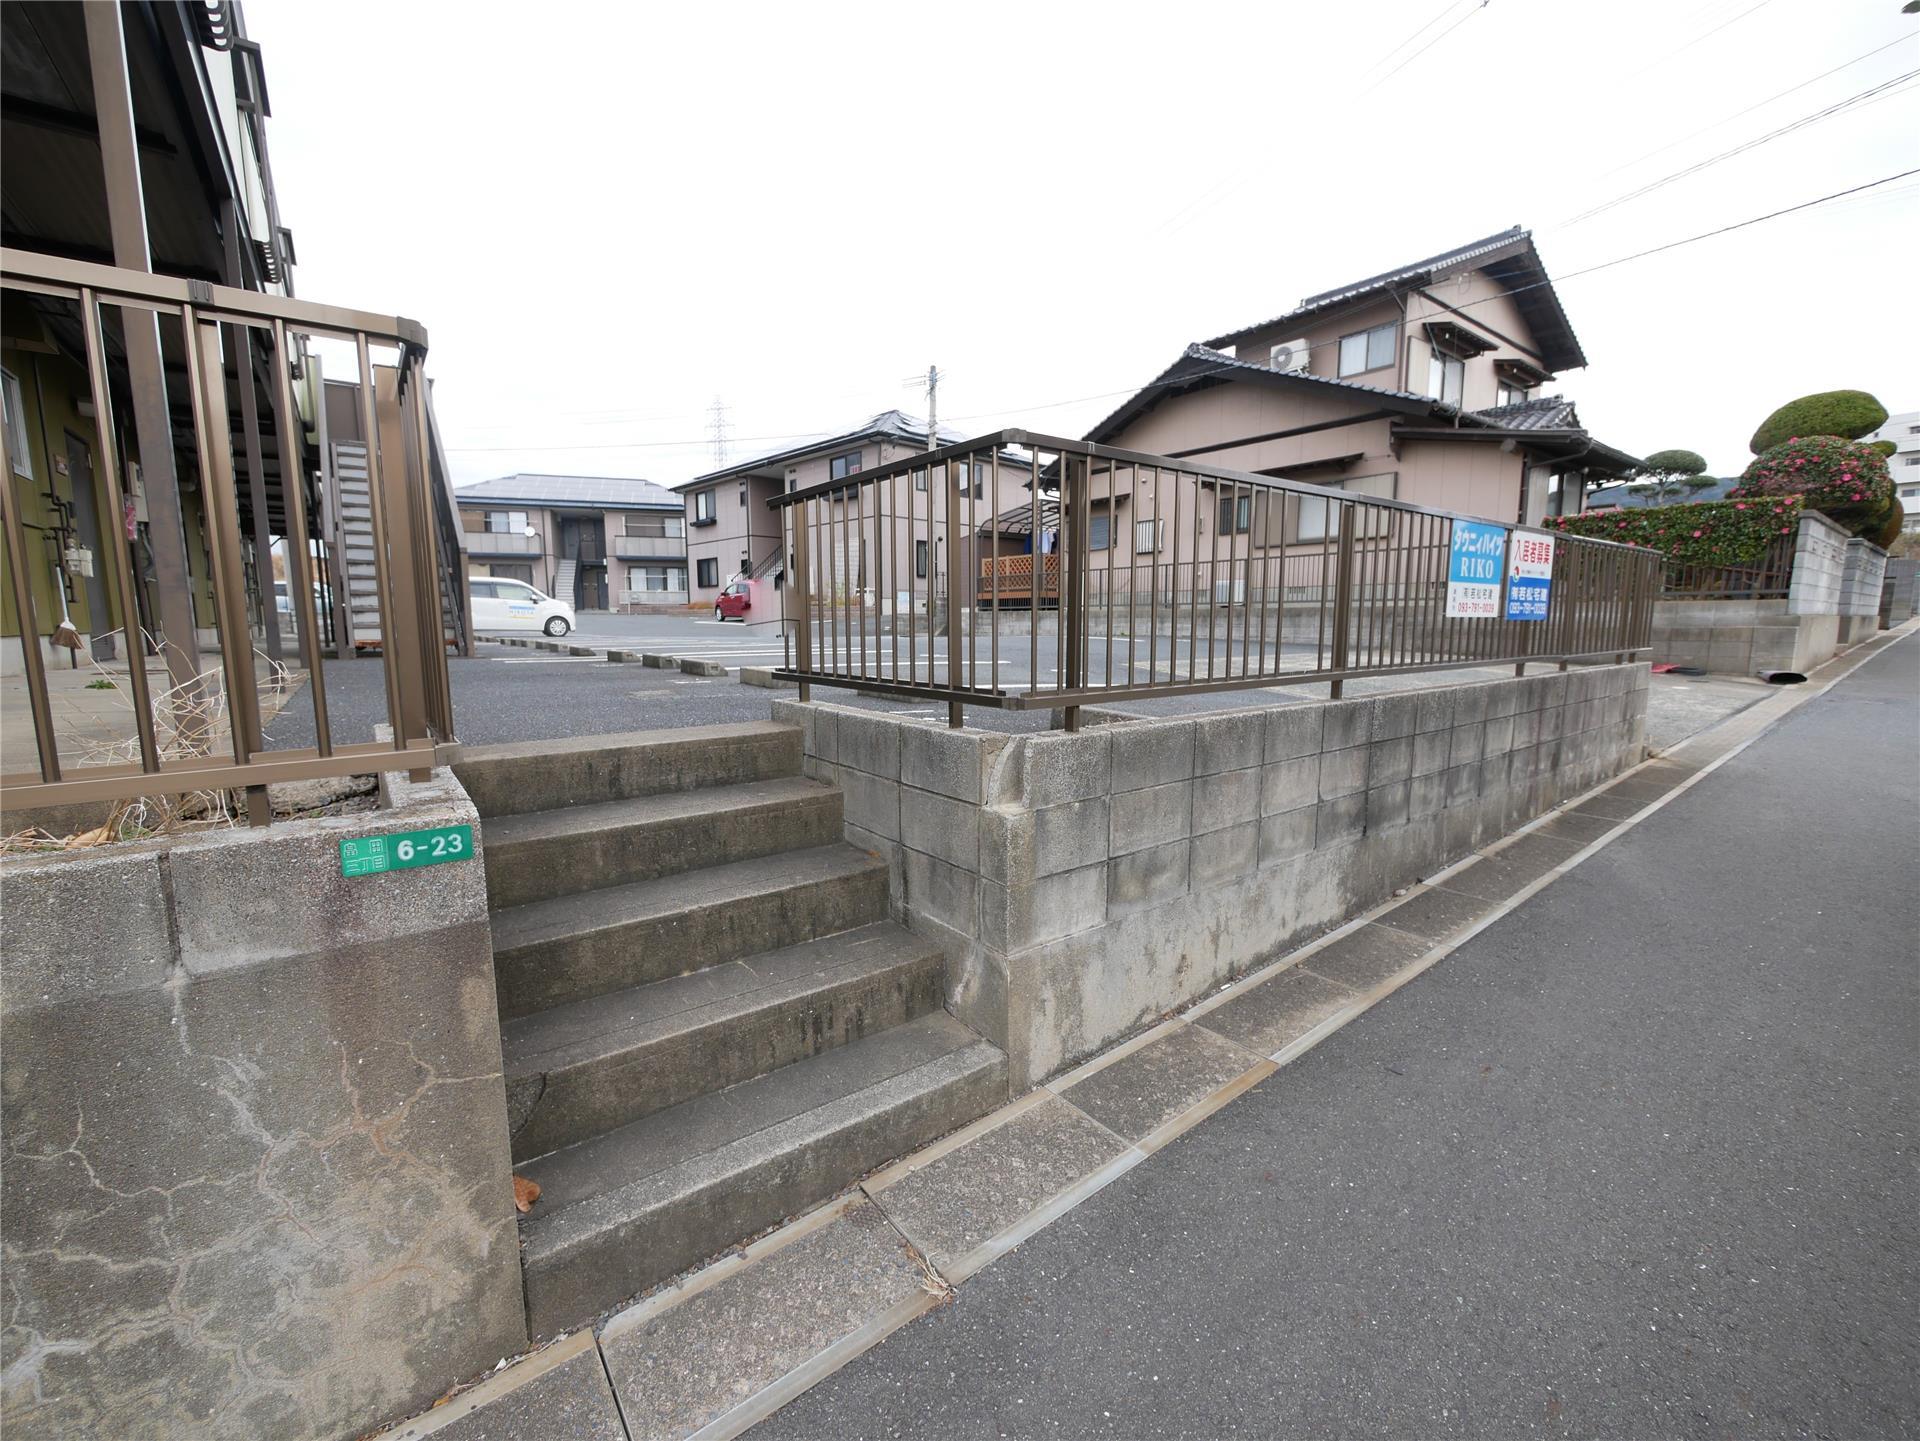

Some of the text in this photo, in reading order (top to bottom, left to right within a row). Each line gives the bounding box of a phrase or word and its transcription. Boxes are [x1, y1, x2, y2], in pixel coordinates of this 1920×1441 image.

[1514, 539, 1551, 564] 入居者募集
[1461, 557, 1494, 578] RIKO
[397, 834, 463, 861] 6-23
